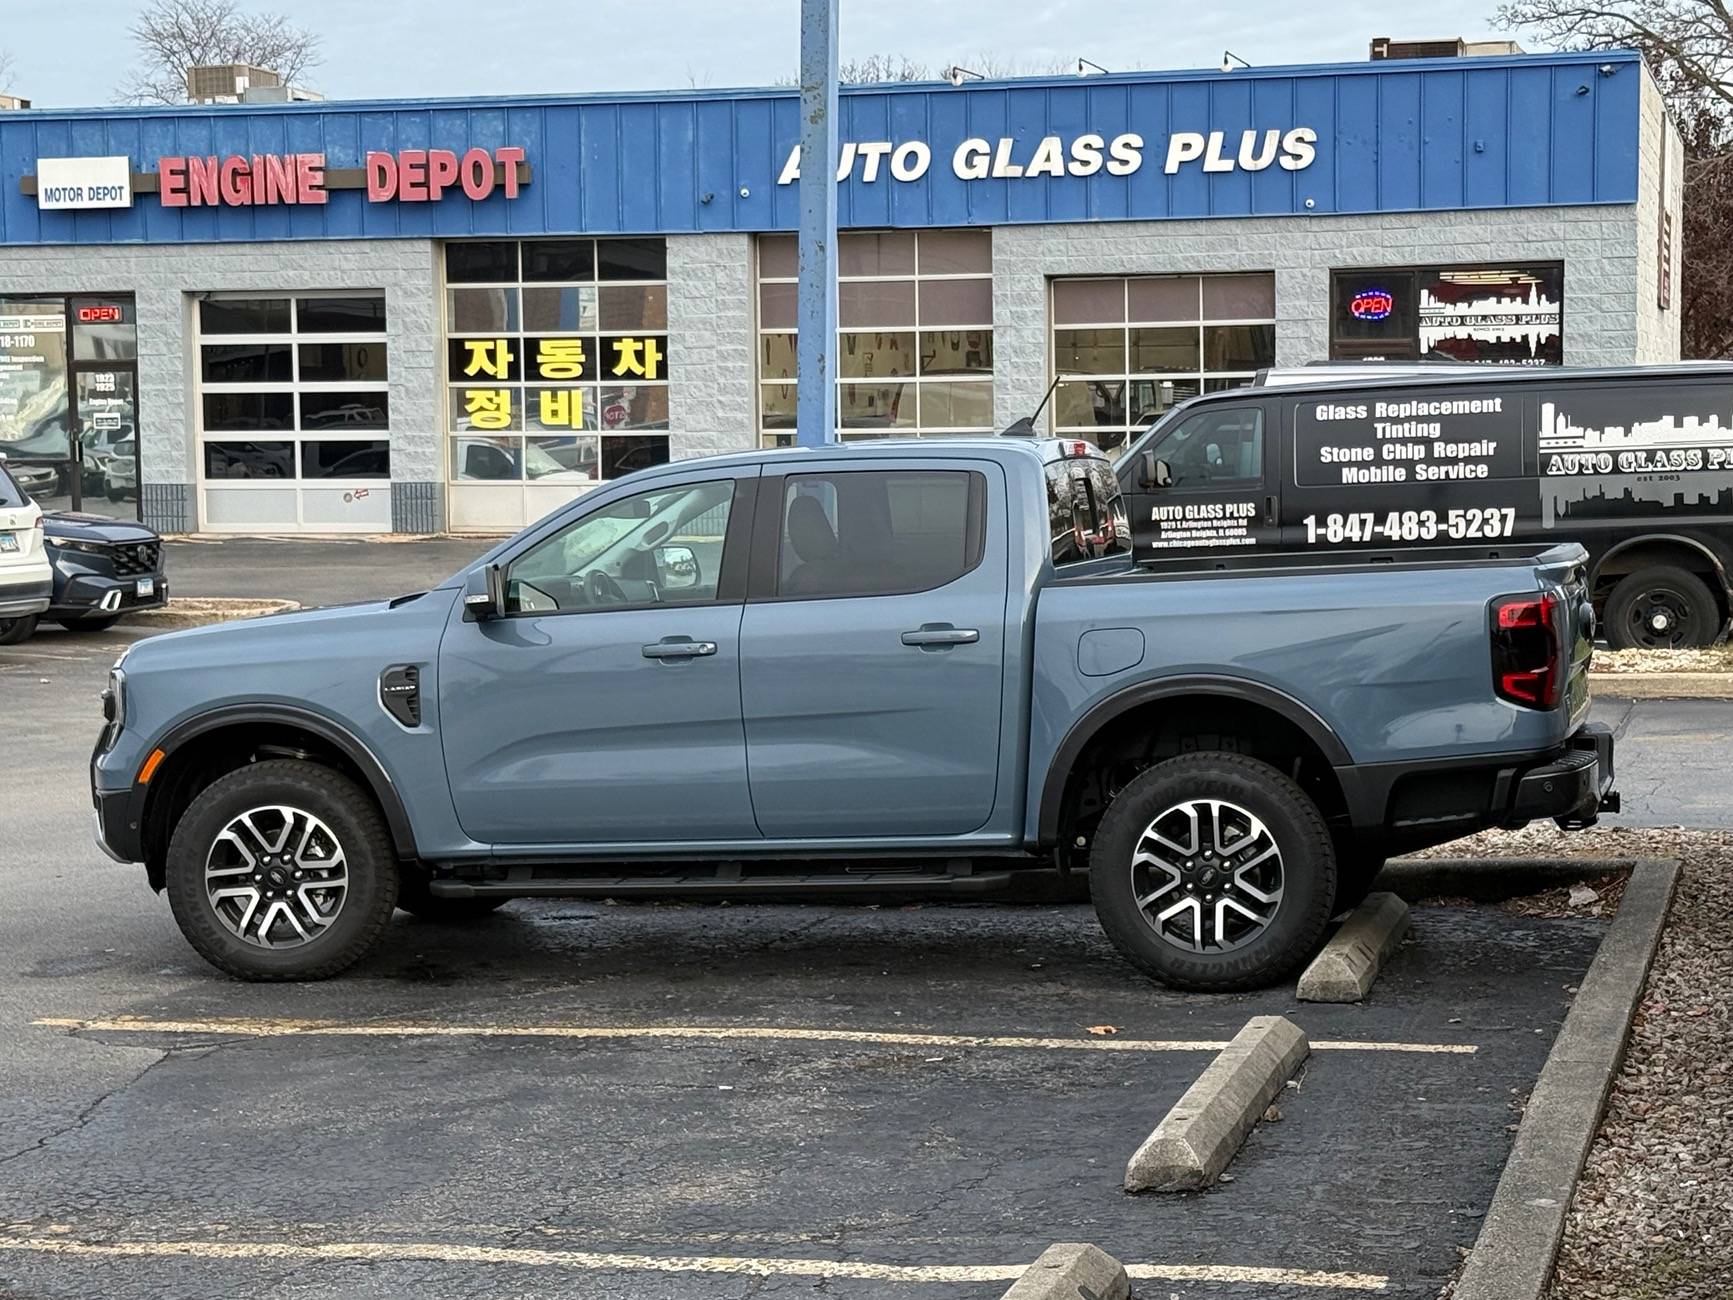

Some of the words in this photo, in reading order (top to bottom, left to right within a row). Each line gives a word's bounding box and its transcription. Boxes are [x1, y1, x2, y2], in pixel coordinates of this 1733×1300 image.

[952, 133, 1144, 180] GLASS
[1164, 127, 1317, 175] PLUS
[159, 153, 328, 207] ENGINE
[367, 147, 525, 203] DEPOT
[44, 187, 83, 203] MOTOR
[88, 186, 125, 202] DEPOT
[80, 308, 119, 320] OPEN
[1351, 297, 1393, 314] OPEN
[1420, 315, 1461, 327] AUTO
[1464, 314, 1516, 326] GLASS
[1518, 313, 1560, 325] PLUS
[464, 338, 663, 380] 자동차
[464, 389, 584, 429] 정비
[1315, 404, 1368, 421] Glass
[1375, 397, 1502, 419] Replacement
[1374, 421, 1441, 439] Tinting
[1320, 446, 1375, 463] Stone
[1382, 442, 1425, 461] Chip
[1433, 439, 1497, 459] Repair
[1547, 453, 1613, 475] AUTO
[1618, 449, 1702, 473] GLASS
[1341, 465, 1406, 484] Mobile
[1415, 462, 1489, 481] Service
[1151, 506, 1183, 521] AUTO
[1185, 504, 1223, 519] GLASS
[1225, 503, 1256, 518] PLUS
[1161, 531, 1191, 539] Arlington
[1182, 520, 1212, 529] Arlington
[1302, 507, 1516, 544] 1-847-483-5237
